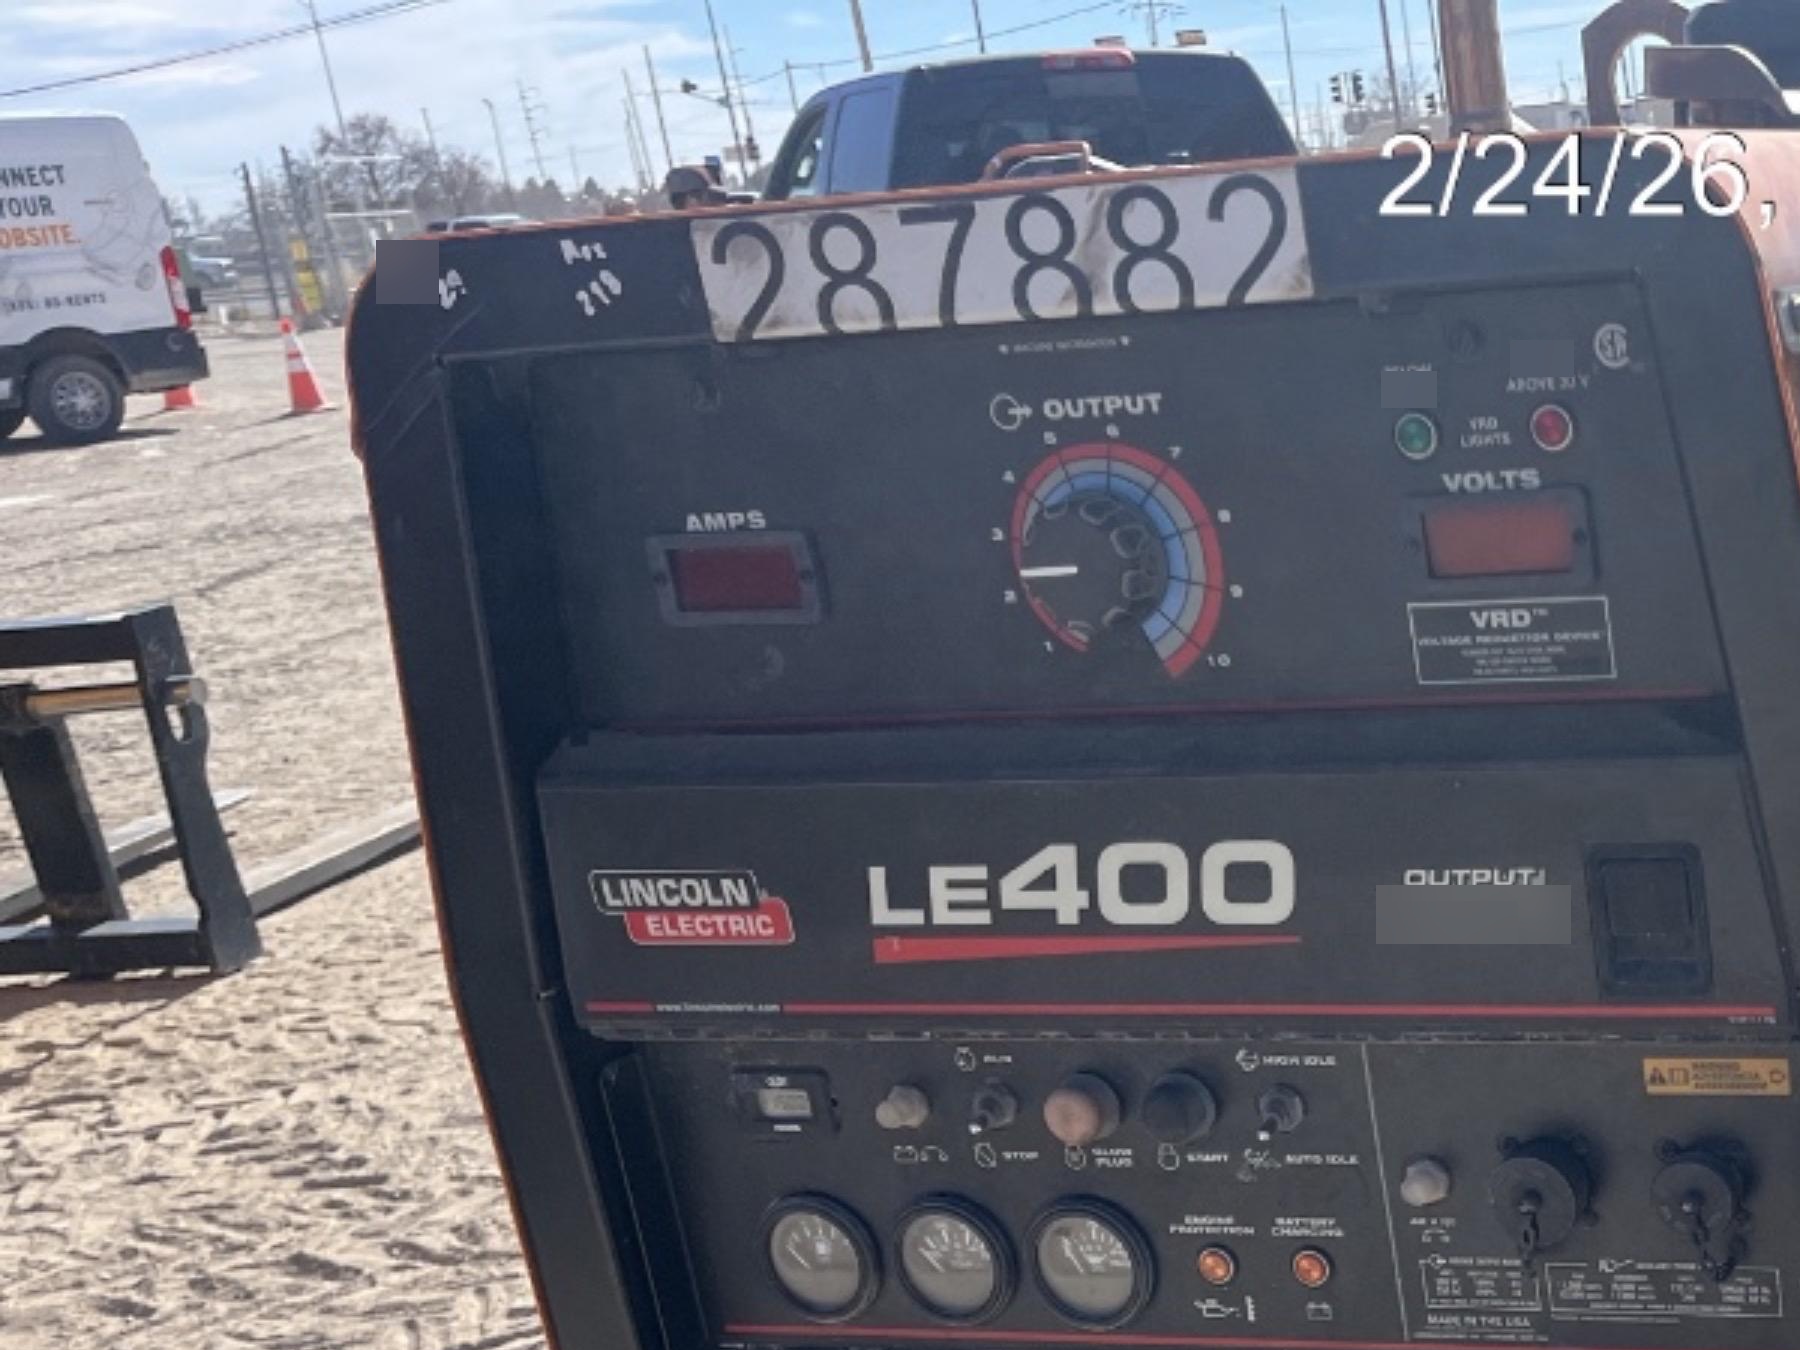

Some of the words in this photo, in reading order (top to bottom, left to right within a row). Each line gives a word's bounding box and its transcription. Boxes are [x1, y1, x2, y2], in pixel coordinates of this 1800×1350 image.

[711, 173, 1290, 342] 287882
[1043, 392, 1162, 420] OUTPUT
[1441, 468, 1541, 493] VOLTS
[686, 510, 767, 533] AMPS
[601, 878, 751, 907] LINCOLN
[867, 840, 1296, 926] LE400
[645, 914, 776, 937] ELECTRIC
